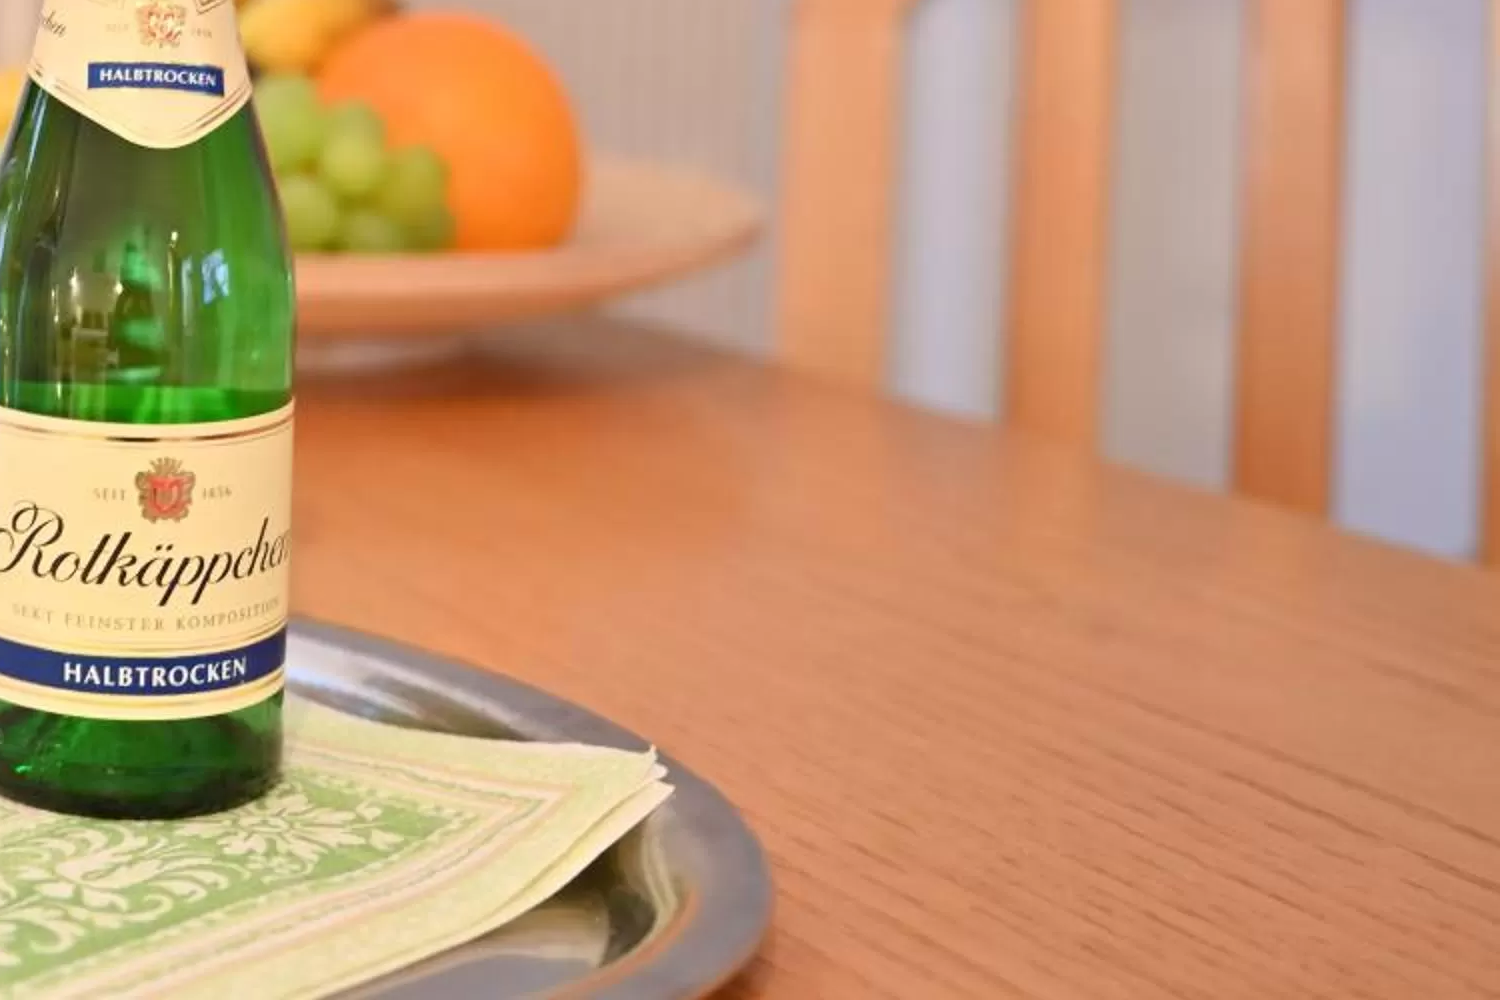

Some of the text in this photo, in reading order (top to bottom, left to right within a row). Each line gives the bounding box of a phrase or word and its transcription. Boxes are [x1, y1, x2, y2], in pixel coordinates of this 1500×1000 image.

[100, 69, 217, 87] HALBTROCKEN
[12, 603, 54, 625] SEKT
[64, 612, 165, 631] FEINSTER
[63, 656, 247, 687] HALBTROCKEN
